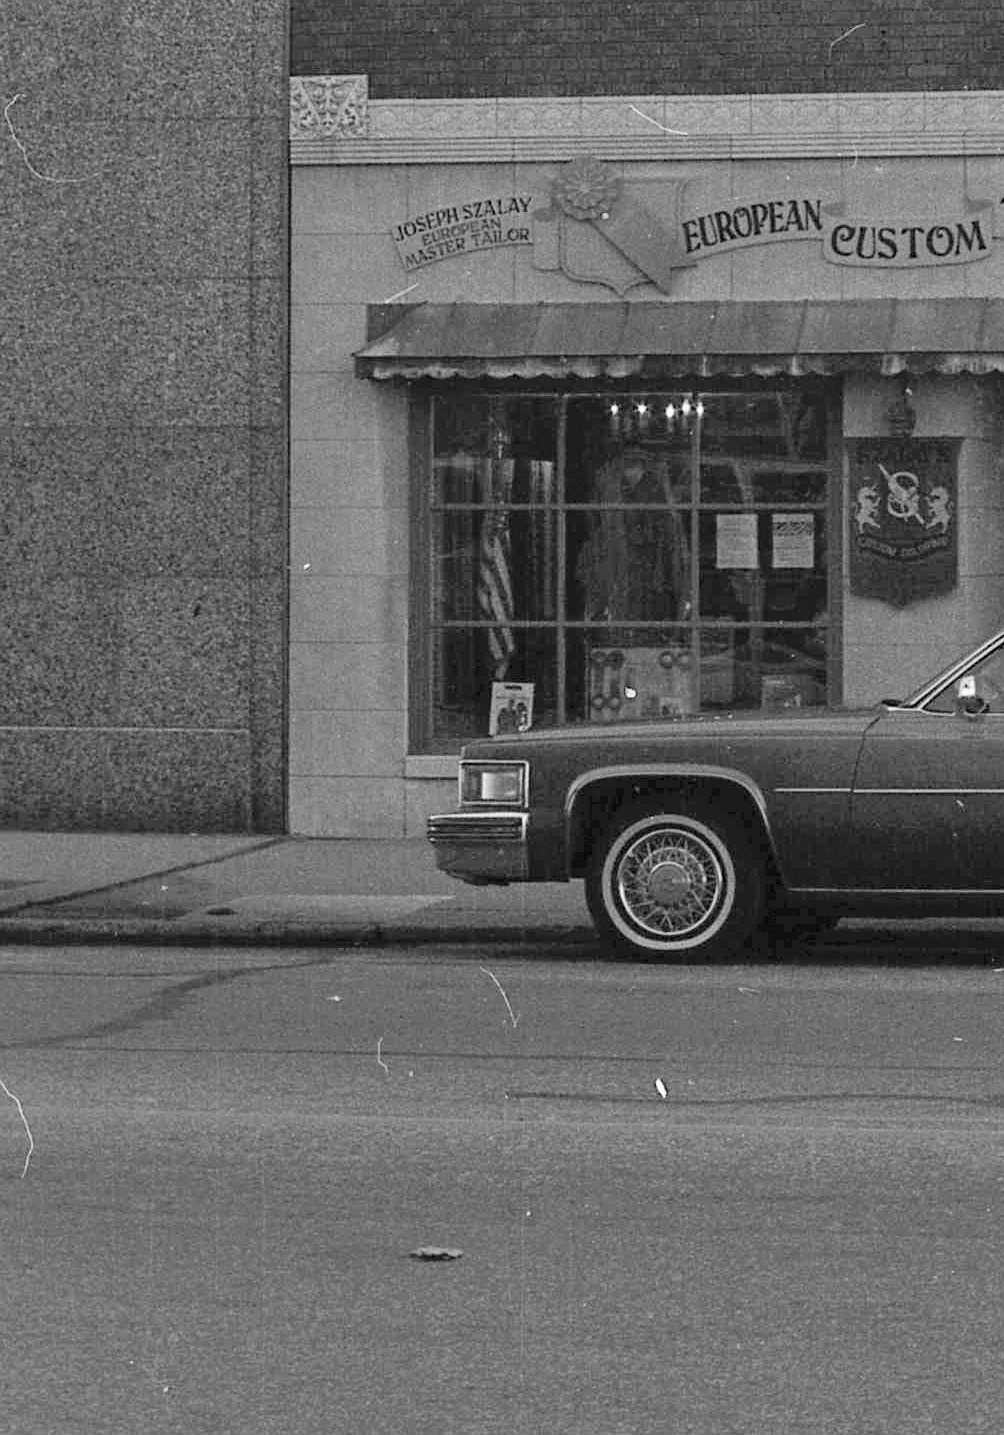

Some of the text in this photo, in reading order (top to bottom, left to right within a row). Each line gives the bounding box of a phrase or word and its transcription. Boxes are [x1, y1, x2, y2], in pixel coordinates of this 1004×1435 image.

[396, 197, 532, 241] JOSEPH SZALAY
[422, 218, 501, 245] EUROPEAN
[682, 199, 824, 253] EUROPEAN
[832, 221, 987, 259] CUSTOM
[405, 228, 530, 268] MASTER TAILOR
